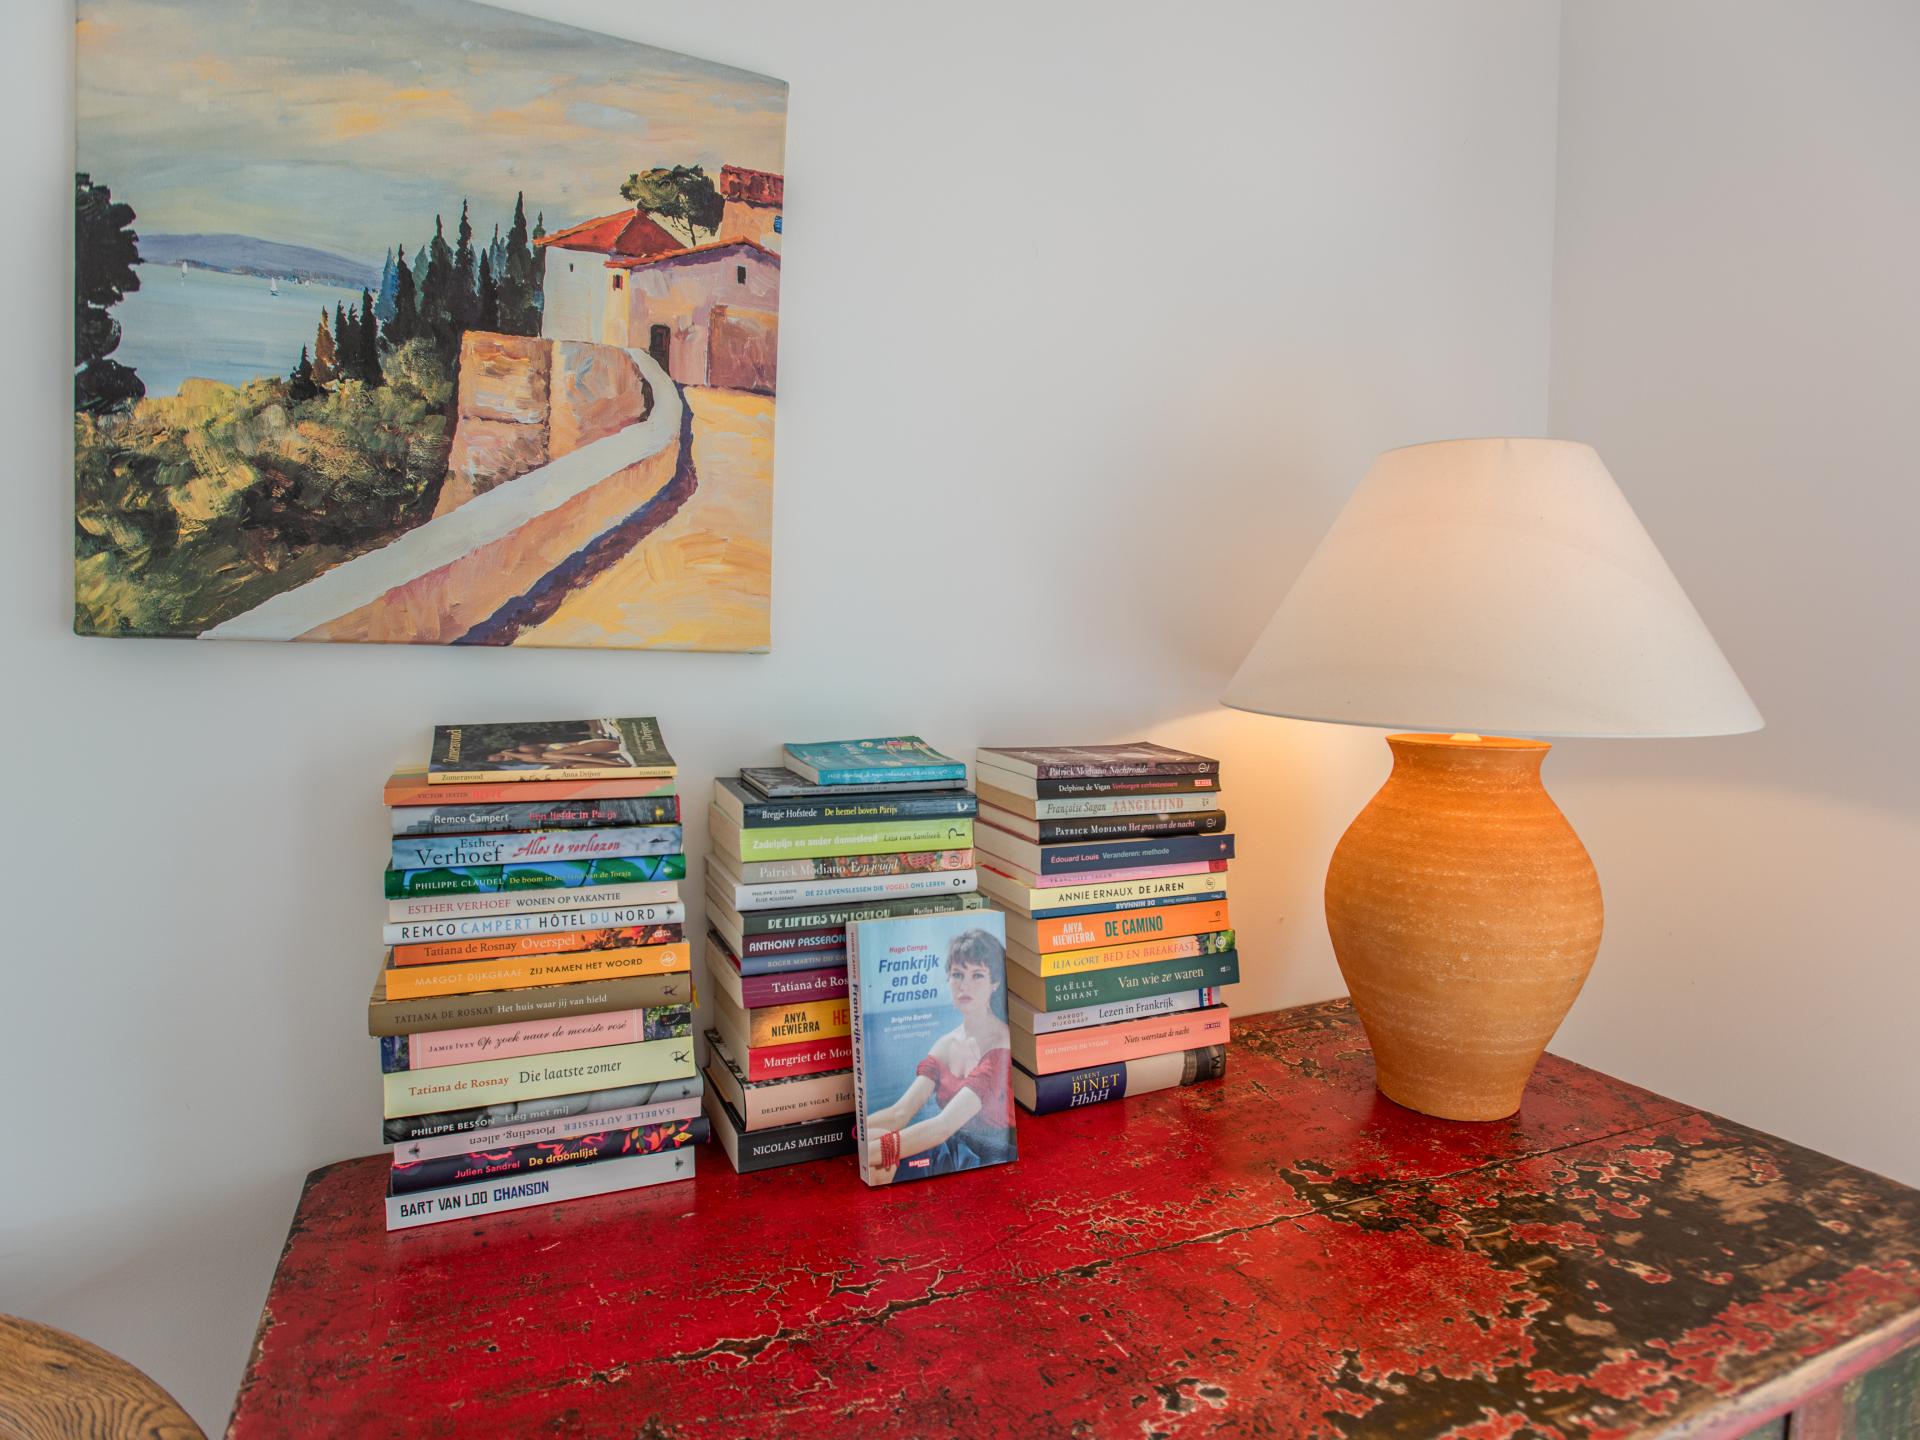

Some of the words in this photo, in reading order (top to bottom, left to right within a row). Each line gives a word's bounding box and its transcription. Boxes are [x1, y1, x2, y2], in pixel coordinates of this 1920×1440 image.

[441, 773, 483, 781] Zomeravond
[1050, 767, 1075, 776] Patrick
[1077, 766, 1107, 775] Modiano
[1110, 765, 1149, 775] Nachtronde
[1058, 784, 1084, 793] Delphine
[1095, 783, 1111, 791] Vigan
[762, 810, 784, 820] Bregje
[786, 808, 817, 818] Hofstede
[824, 808, 833, 816] De
[835, 807, 857, 816] hemel
[858, 806, 877, 815] boven
[880, 804, 898, 815] Parijs
[1084, 802, 1106, 814] Sagan
[434, 815, 466, 824] Remco
[469, 813, 509, 825] Campert
[550, 810, 576, 820] liefde
[580, 810, 588, 819] in
[1055, 827, 1088, 836] PATRICK
[1091, 825, 1127, 834] MODIANO
[1128, 822, 1141, 831] Het
[1169, 820, 1177, 828] de
[1178, 820, 1195, 828] nacht
[460, 838, 497, 849] Esther
[512, 836, 549, 857] Alles
[553, 843, 563, 853] te
[568, 833, 620, 852] verliezen
[415, 844, 504, 866] Verhoef
[1081, 853, 1099, 861] Louis
[1142, 848, 1170, 856] methode
[760, 864, 798, 879] Patrick
[801, 862, 846, 877] Modiano
[415, 880, 457, 890] PHILIPPE
[461, 878, 504, 888] CLAUDEL
[805, 889, 814, 897] DE
[825, 885, 871, 895] LEVENSLESSEN
[885, 883, 909, 891] VOGELS
[1059, 891, 1090, 902] ANNIE
[1093, 887, 1133, 899] ERNAUX
[1139, 885, 1151, 894] DE
[1154, 882, 1184, 893] JAREN
[408, 903, 454, 915] ESTHER
[456, 899, 511, 911] VERHOEF
[516, 897, 555, 907] WONEN
[558, 896, 571, 905] OP
[573, 892, 621, 903] VAKANTIE
[402, 924, 456, 939] REMCO
[461, 918, 531, 934] CAMPERT
[539, 914, 585, 928] HÔTEL
[590, 913, 609, 924] DU
[615, 909, 655, 922] NORD
[768, 919, 782, 929] DE
[829, 913, 849, 924] VAN
[1063, 922, 1083, 934] ANYA
[1105, 920, 1119, 937] DE
[1122, 915, 1163, 935] CAMINO
[424, 945, 463, 957] Tatiana
[465, 943, 477, 953] de
[480, 942, 517, 953] Rosnay
[521, 935, 575, 950] Overspel
[749, 940, 796, 952] ANTHONY
[798, 934, 847, 947] PASSERON
[1052, 932, 1096, 946] NIEWIERRA
[907, 944, 928, 953] Camps
[1103, 951, 1123, 962] BED
[1127, 950, 1140, 959] EN
[1143, 941, 1195, 957] BREAKFAST
[794, 957, 820, 965] MARTIN
[879, 954, 940, 973] Frankrijk
[415, 974, 462, 986] MARGOT
[467, 968, 521, 981] DIJKGRAAF
[530, 968, 543, 976] ZIJ
[546, 964, 582, 974] NAMEN
[586, 961, 602, 970] HET
[606, 958, 643, 969] WOORD
[892, 976, 908, 987] en
[912, 971, 928, 985] de
[1118, 976, 1139, 988] Van
[1142, 972, 1159, 984] wie
[1162, 973, 1172, 983] ze
[1174, 968, 1204, 980] waren
[772, 981, 812, 993] Tatiana
[815, 978, 827, 988] de
[1054, 980, 1094, 992] GAËLLE
[883, 987, 938, 1004] Fransen
[1055, 990, 1099, 1002] NOHANT
[395, 1012, 437, 1024] TATIANA
[441, 1010, 454, 1019] DE
[458, 1007, 494, 1017] ROSNAY
[498, 1004, 513, 1014] Het
[515, 1002, 533, 1011] huis
[536, 1001, 556, 1009] waar
[558, 998, 567, 1008] jij
[586, 994, 607, 1004] hield
[852, 984, 861, 1044] Frankrijk
[1099, 1006, 1124, 1018] Lezen
[1126, 1003, 1134, 1013] in
[1136, 998, 1174, 1012] Frankrijk
[784, 1012, 806, 1024] ANYA
[495, 1031, 519, 1048] zoek
[523, 1032, 549, 1041] naar
[552, 1026, 564, 1037] de
[567, 1023, 604, 1036] mooiste
[607, 1020, 627, 1031] rosé
[771, 1021, 820, 1037] NIEWIERRA
[1141, 1031, 1167, 1041] weerstaat
[764, 1053, 810, 1068] Margriet
[814, 1051, 826, 1061] de
[855, 1047, 860, 1063] en
[408, 1084, 451, 1096] Tatiana
[454, 1081, 467, 1090] de
[471, 1077, 509, 1088] Rosnay
[519, 1069, 541, 1083] Die
[544, 1066, 583, 1080] laatste
[587, 1061, 622, 1075] zomer
[856, 1065, 862, 1083] de
[1072, 1071, 1100, 1082] LAURENT
[1073, 1073, 1120, 1095] BINET
[1070, 1089, 1110, 1107] HhhH
[626, 1107, 675, 1121] ISABELLE
[761, 1104, 796, 1115] DELPHINE
[810, 1098, 830, 1106] VIGAN
[411, 1123, 454, 1137] PHILIPPE
[457, 1118, 496, 1130] BESSON
[505, 1112, 527, 1123] Lieg
[530, 1109, 550, 1119] met
[553, 1106, 569, 1115] mij
[564, 1116, 622, 1131] AUTISSIER
[469, 1134, 500, 1145] alleen
[753, 1140, 796, 1156] NICOLAS
[798, 1132, 844, 1148] MATHIEU
[455, 1168, 482, 1178] Julien
[486, 1161, 520, 1173] Sandrel
[529, 1157, 543, 1167] De
[546, 1148, 598, 1163] droomlijst
[400, 1200, 433, 1218] BART
[438, 1195, 461, 1211] VAN
[465, 1191, 487, 1206] LOO
[493, 1181, 549, 1202] CHANSON
